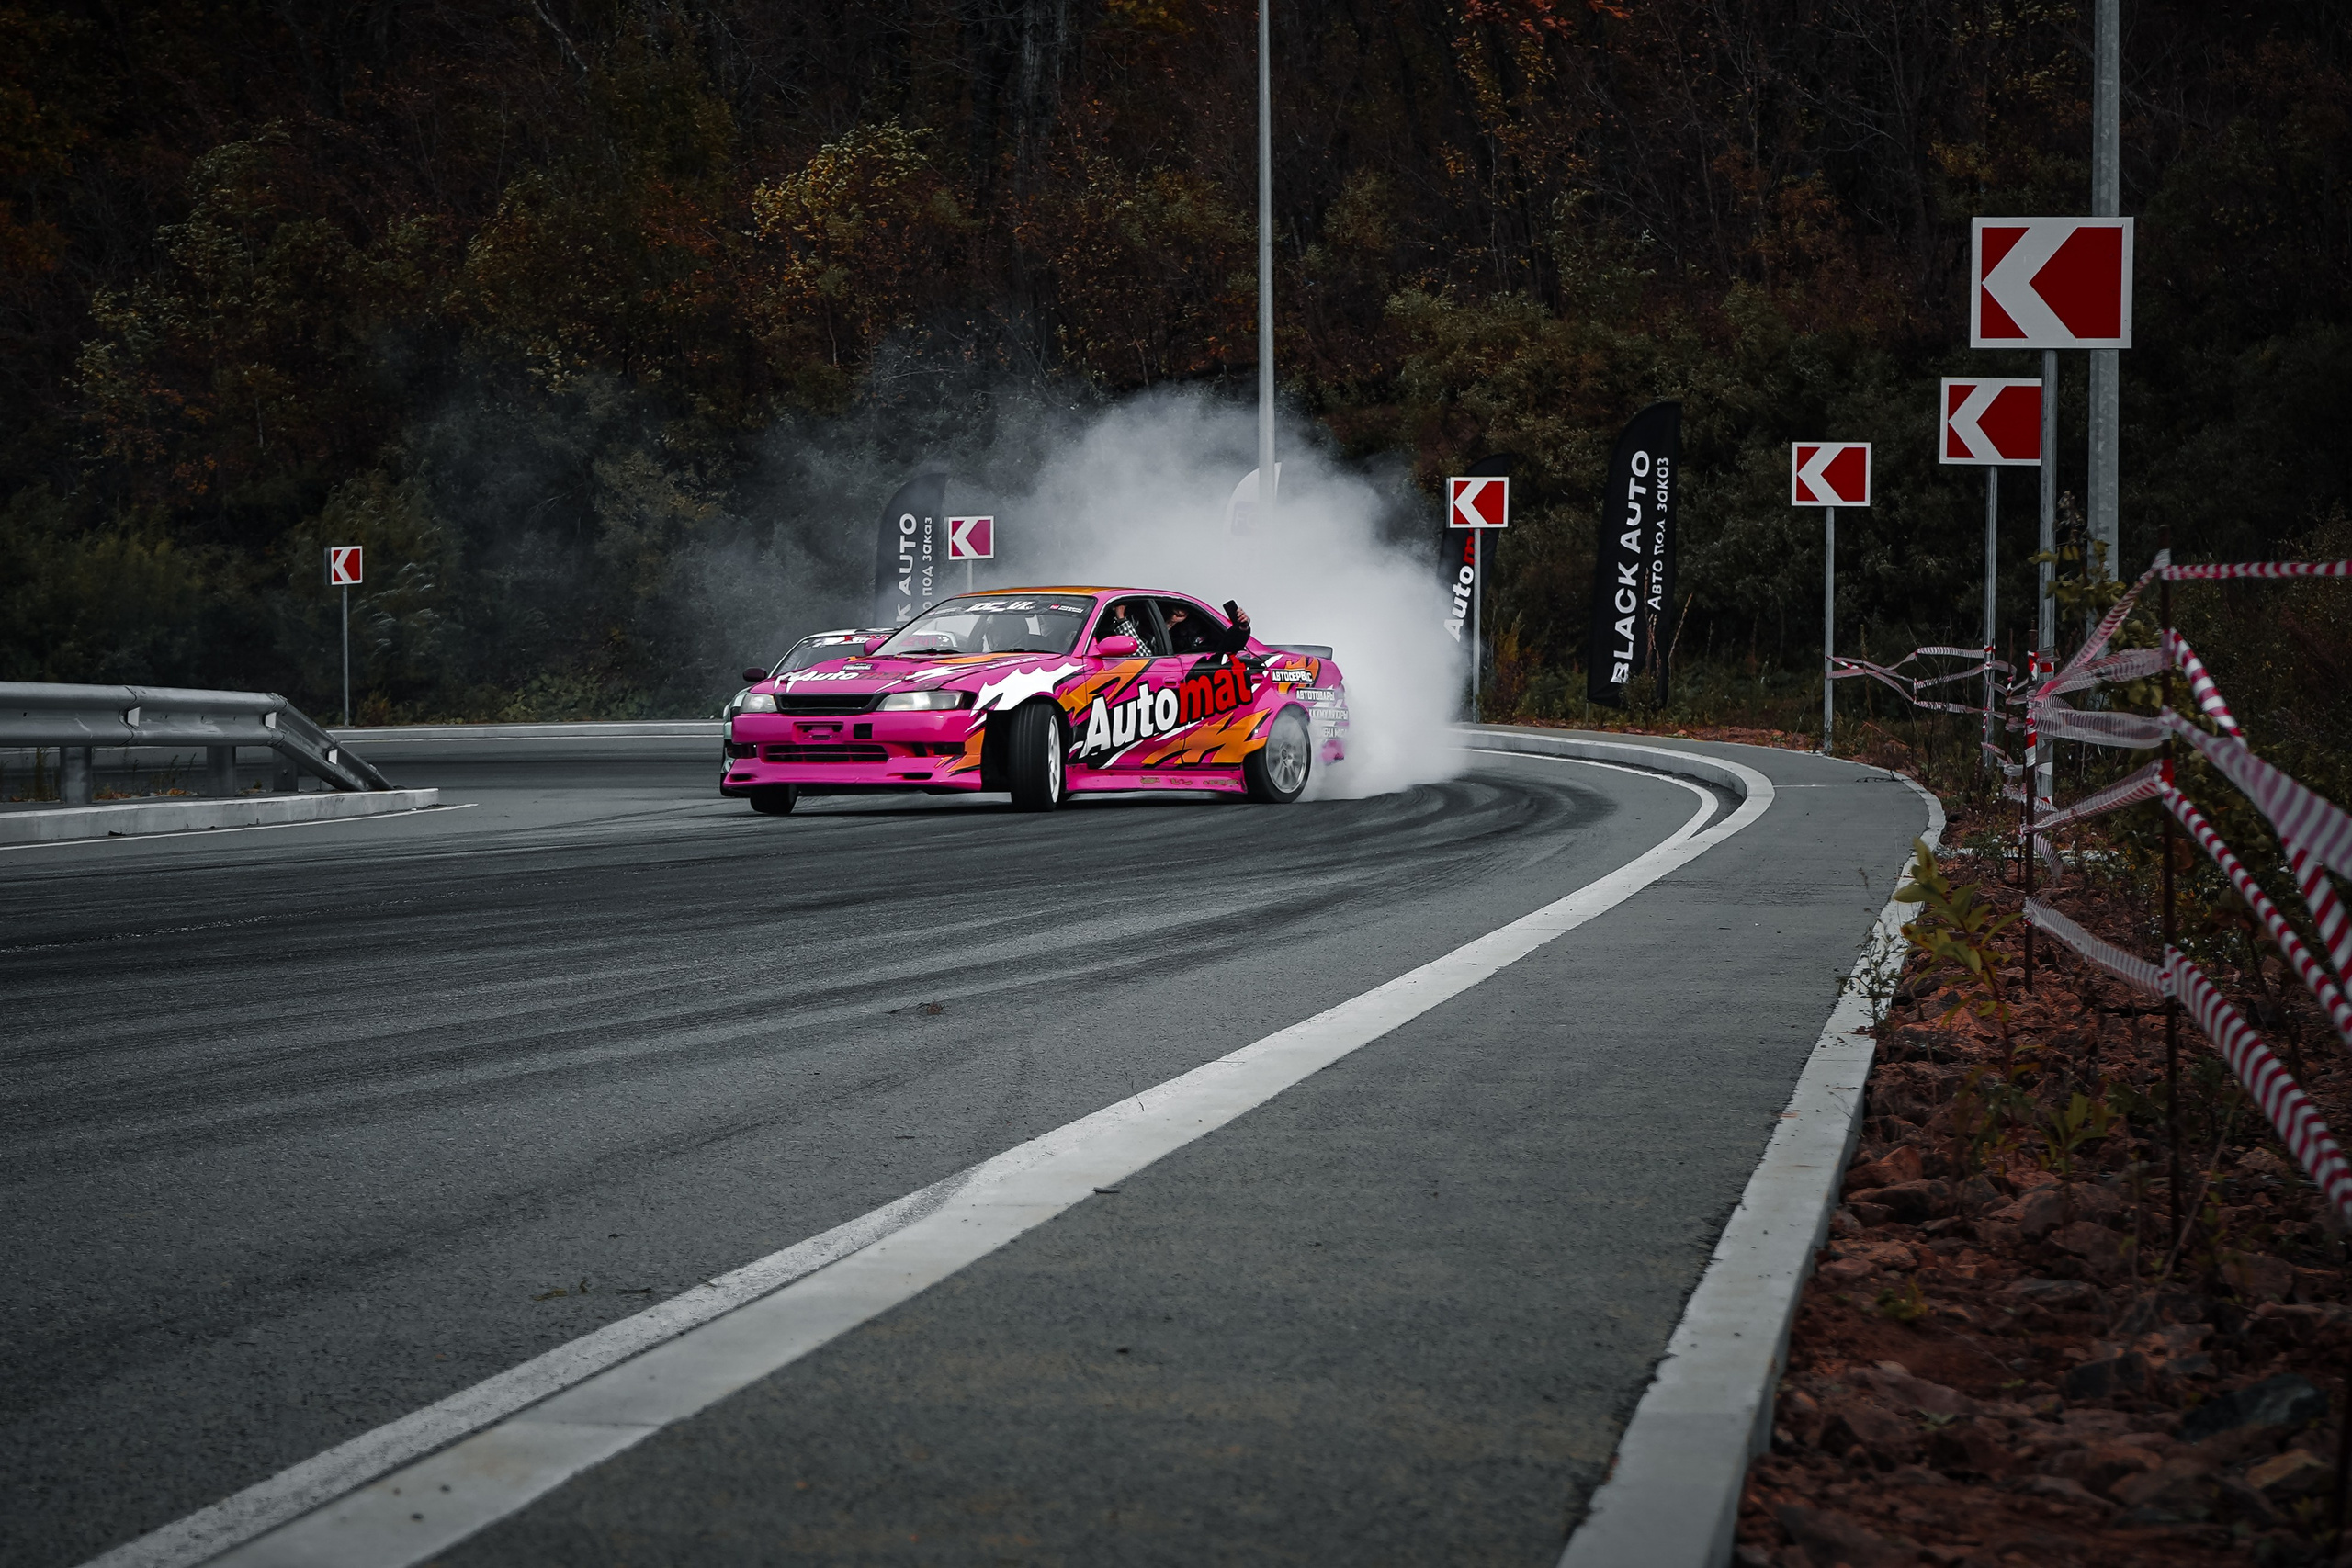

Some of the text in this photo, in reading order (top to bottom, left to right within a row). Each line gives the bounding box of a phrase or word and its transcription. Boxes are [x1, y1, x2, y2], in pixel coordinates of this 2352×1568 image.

[898, 513, 917, 596] AUTO
[1443, 527, 1484, 642] Autom
[1610, 450, 1650, 683] BLACK AUTO
[1080, 653, 1252, 759] Automat
